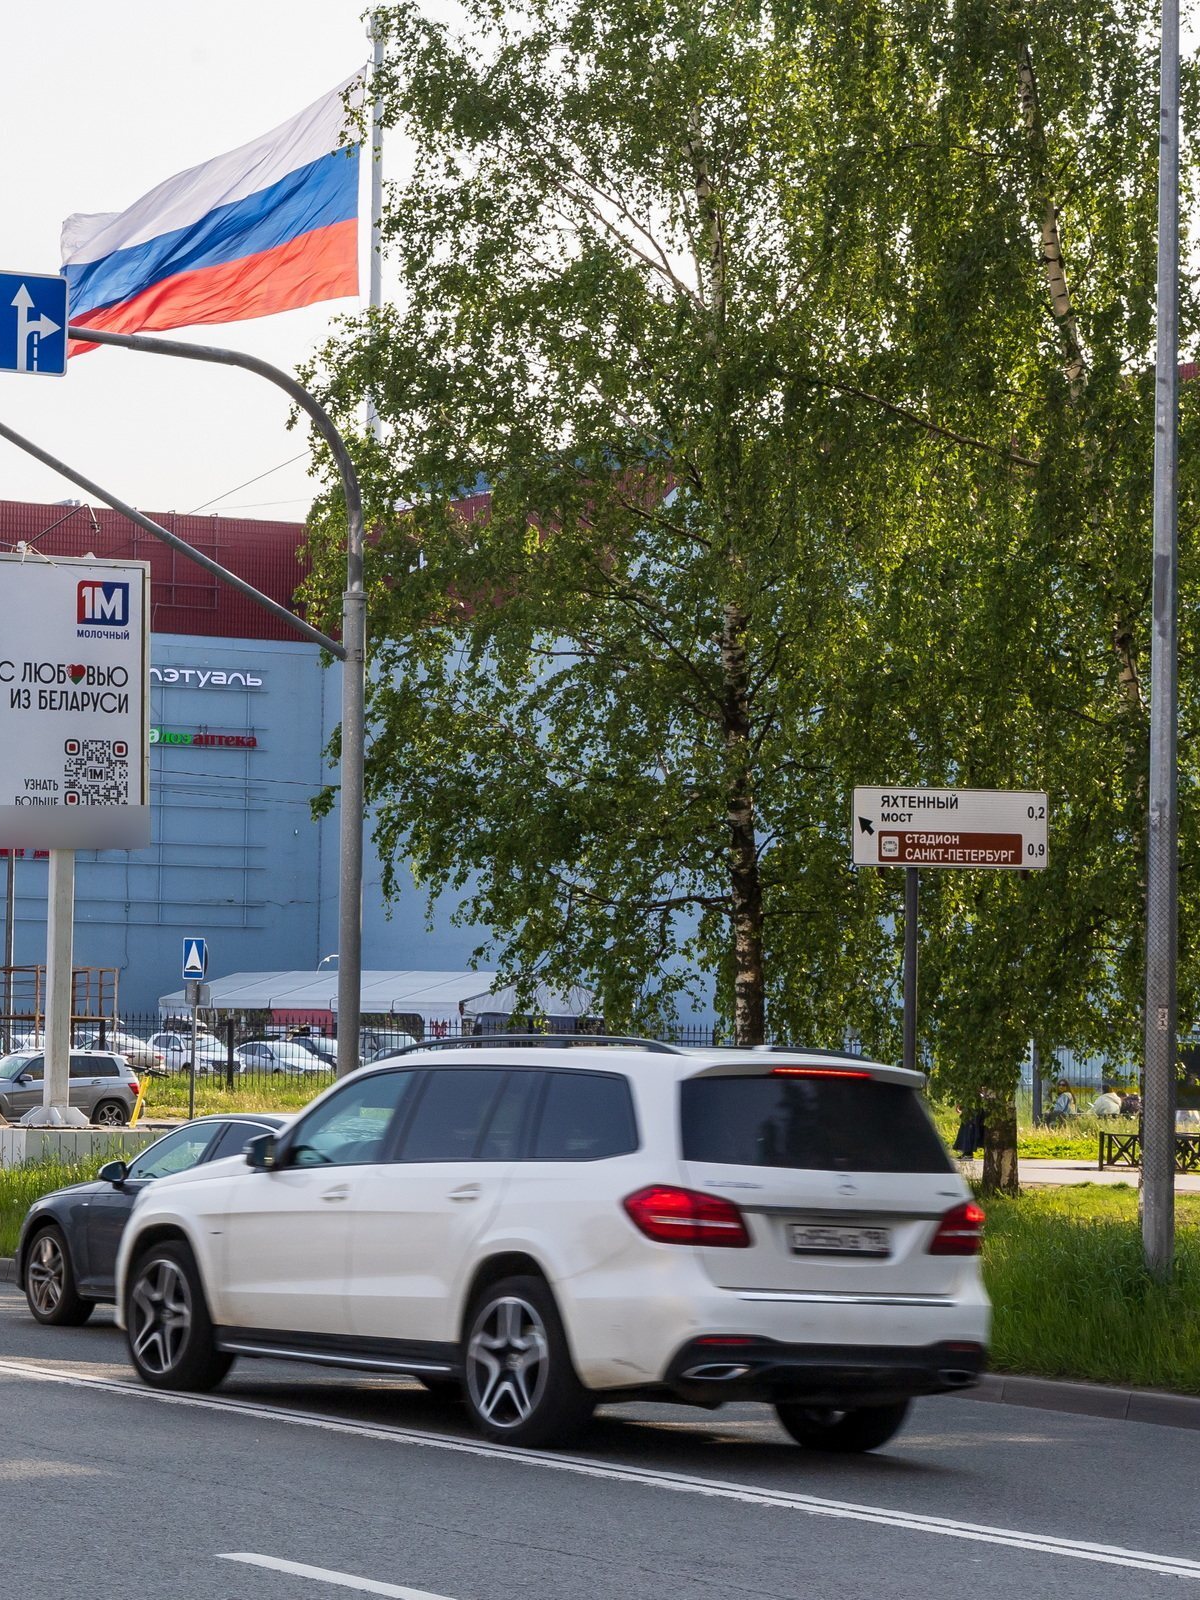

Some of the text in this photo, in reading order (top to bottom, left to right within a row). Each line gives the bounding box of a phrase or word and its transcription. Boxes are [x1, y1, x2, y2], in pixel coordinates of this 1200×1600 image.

[77, 629, 130, 640] МОЛОЧНЫЙ
[10, 688, 129, 714] ИЗ БЕЛАРУСИ
[23, 778, 59, 791] УЗНАТЬ
[880, 793, 959, 810] ЯХТЕННЫЙ
[1027, 805, 1045, 821] 0,2
[905, 833, 960, 846] стадион
[905, 847, 1015, 862] САНКТ-ПЕТЕРБУРГ
[1027, 843, 1045, 858] 0,9
